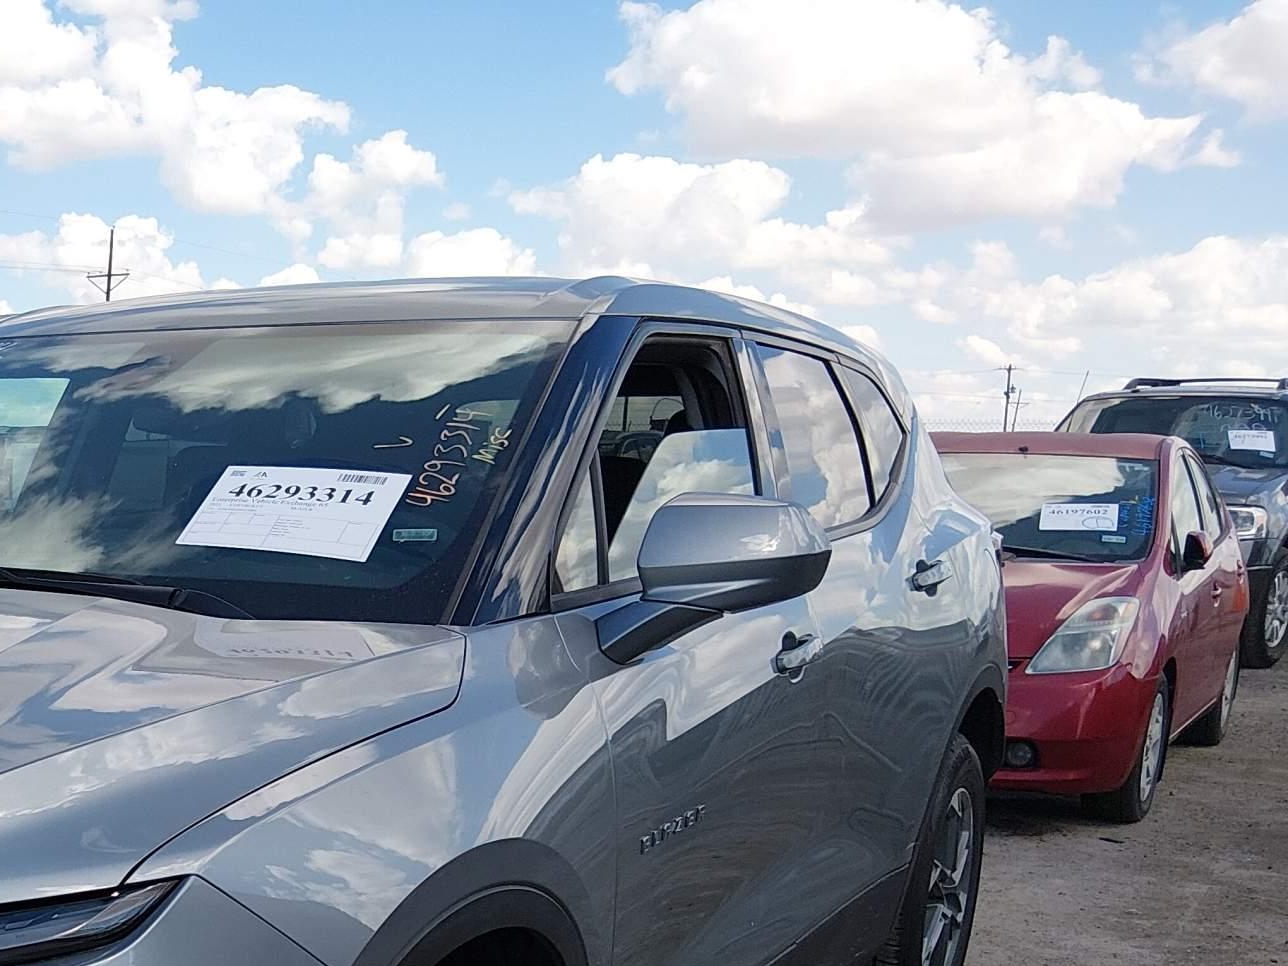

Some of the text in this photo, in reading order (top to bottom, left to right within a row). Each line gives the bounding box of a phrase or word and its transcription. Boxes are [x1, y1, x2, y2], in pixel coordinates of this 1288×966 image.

[405, 406, 494, 507] 46293314
[228, 482, 376, 506] 46293314
[1048, 508, 1109, 516] 46197602
